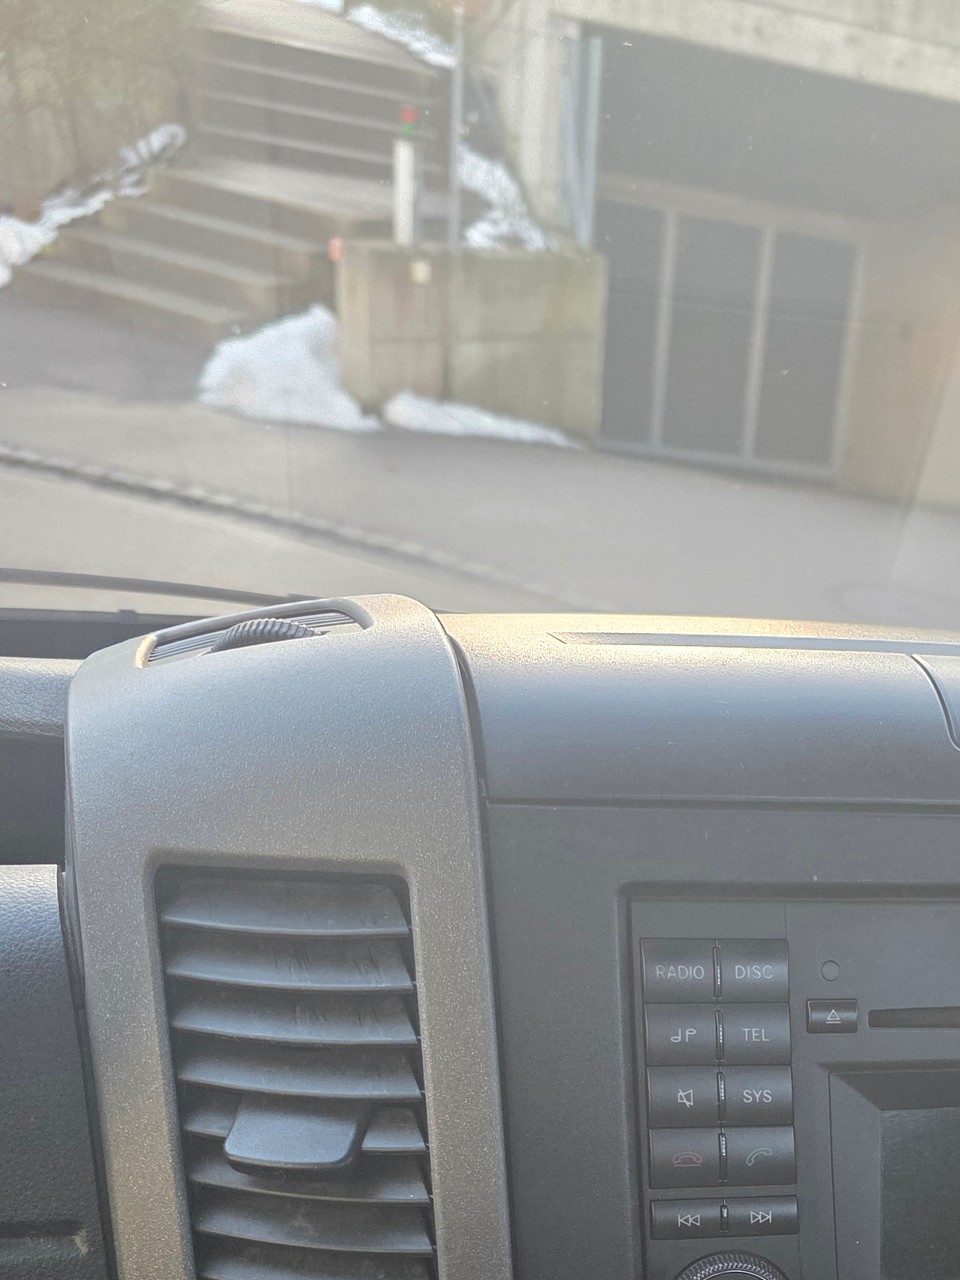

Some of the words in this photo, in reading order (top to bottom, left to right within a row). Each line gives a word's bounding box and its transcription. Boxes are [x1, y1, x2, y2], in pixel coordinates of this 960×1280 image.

[656, 965, 705, 980] RADIO
[734, 965, 774, 980] DISC
[742, 1028, 771, 1042] TEL
[743, 1089, 773, 1104] SYS
